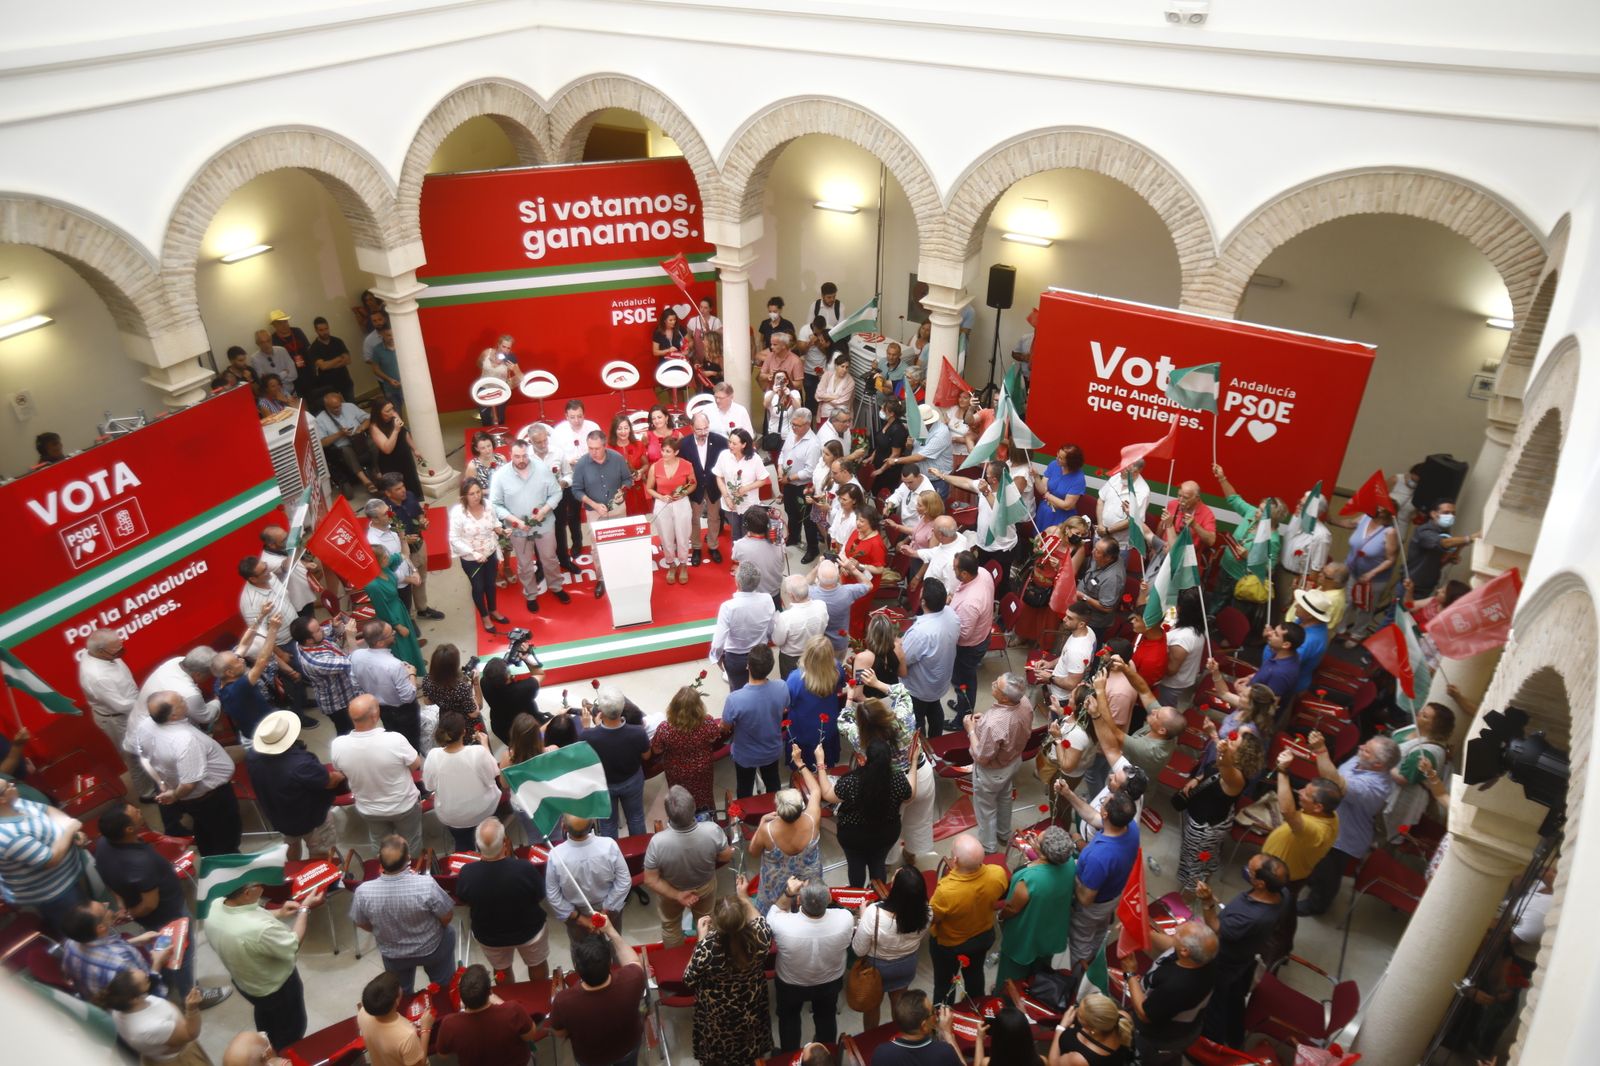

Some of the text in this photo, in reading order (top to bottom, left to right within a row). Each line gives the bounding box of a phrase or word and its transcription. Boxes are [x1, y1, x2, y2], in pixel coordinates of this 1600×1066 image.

[519, 193, 694, 224] Si votamos,
[523, 218, 698, 260] ganamos.
[612, 297, 655, 308] Andalucía
[612, 308, 657, 326] PSOE
[1088, 382, 1112, 394] por
[1114, 385, 1126, 397] la
[1230, 377, 1296, 399] Andalucía
[1087, 394, 1204, 430] que quieres.
[1224, 390, 1295, 424] PSOE
[27, 461, 142, 526] VOTA
[67, 523, 101, 548] PSOE
[65, 560, 208, 645] Por la Andalucía
[116, 599, 182, 641] quieres.
